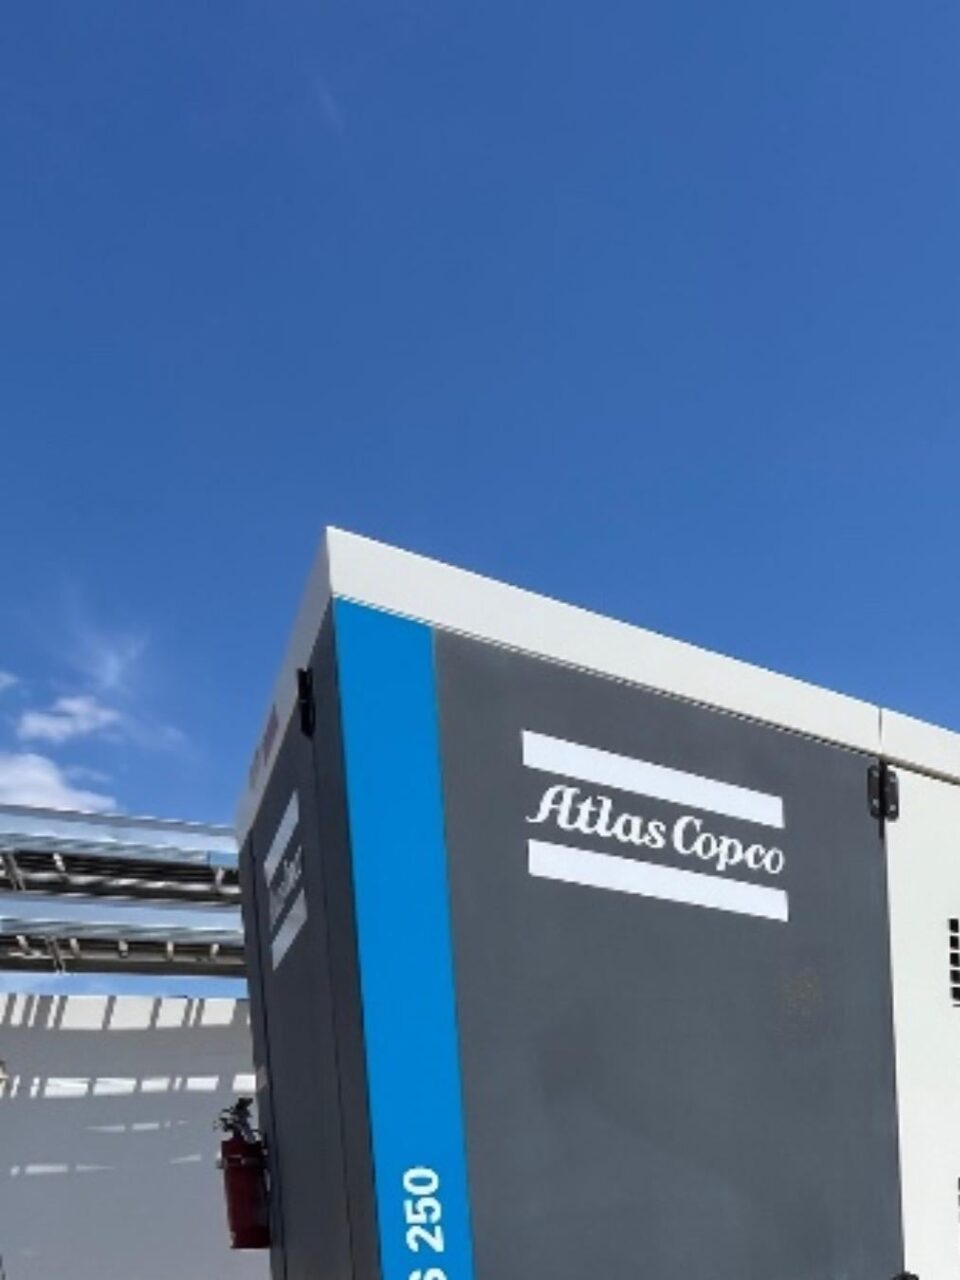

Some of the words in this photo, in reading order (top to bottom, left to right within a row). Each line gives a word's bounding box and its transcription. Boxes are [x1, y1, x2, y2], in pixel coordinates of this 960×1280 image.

[526, 784, 667, 849] Atlas
[671, 815, 786, 874] Copco
[402, 1166, 446, 1254] 250
